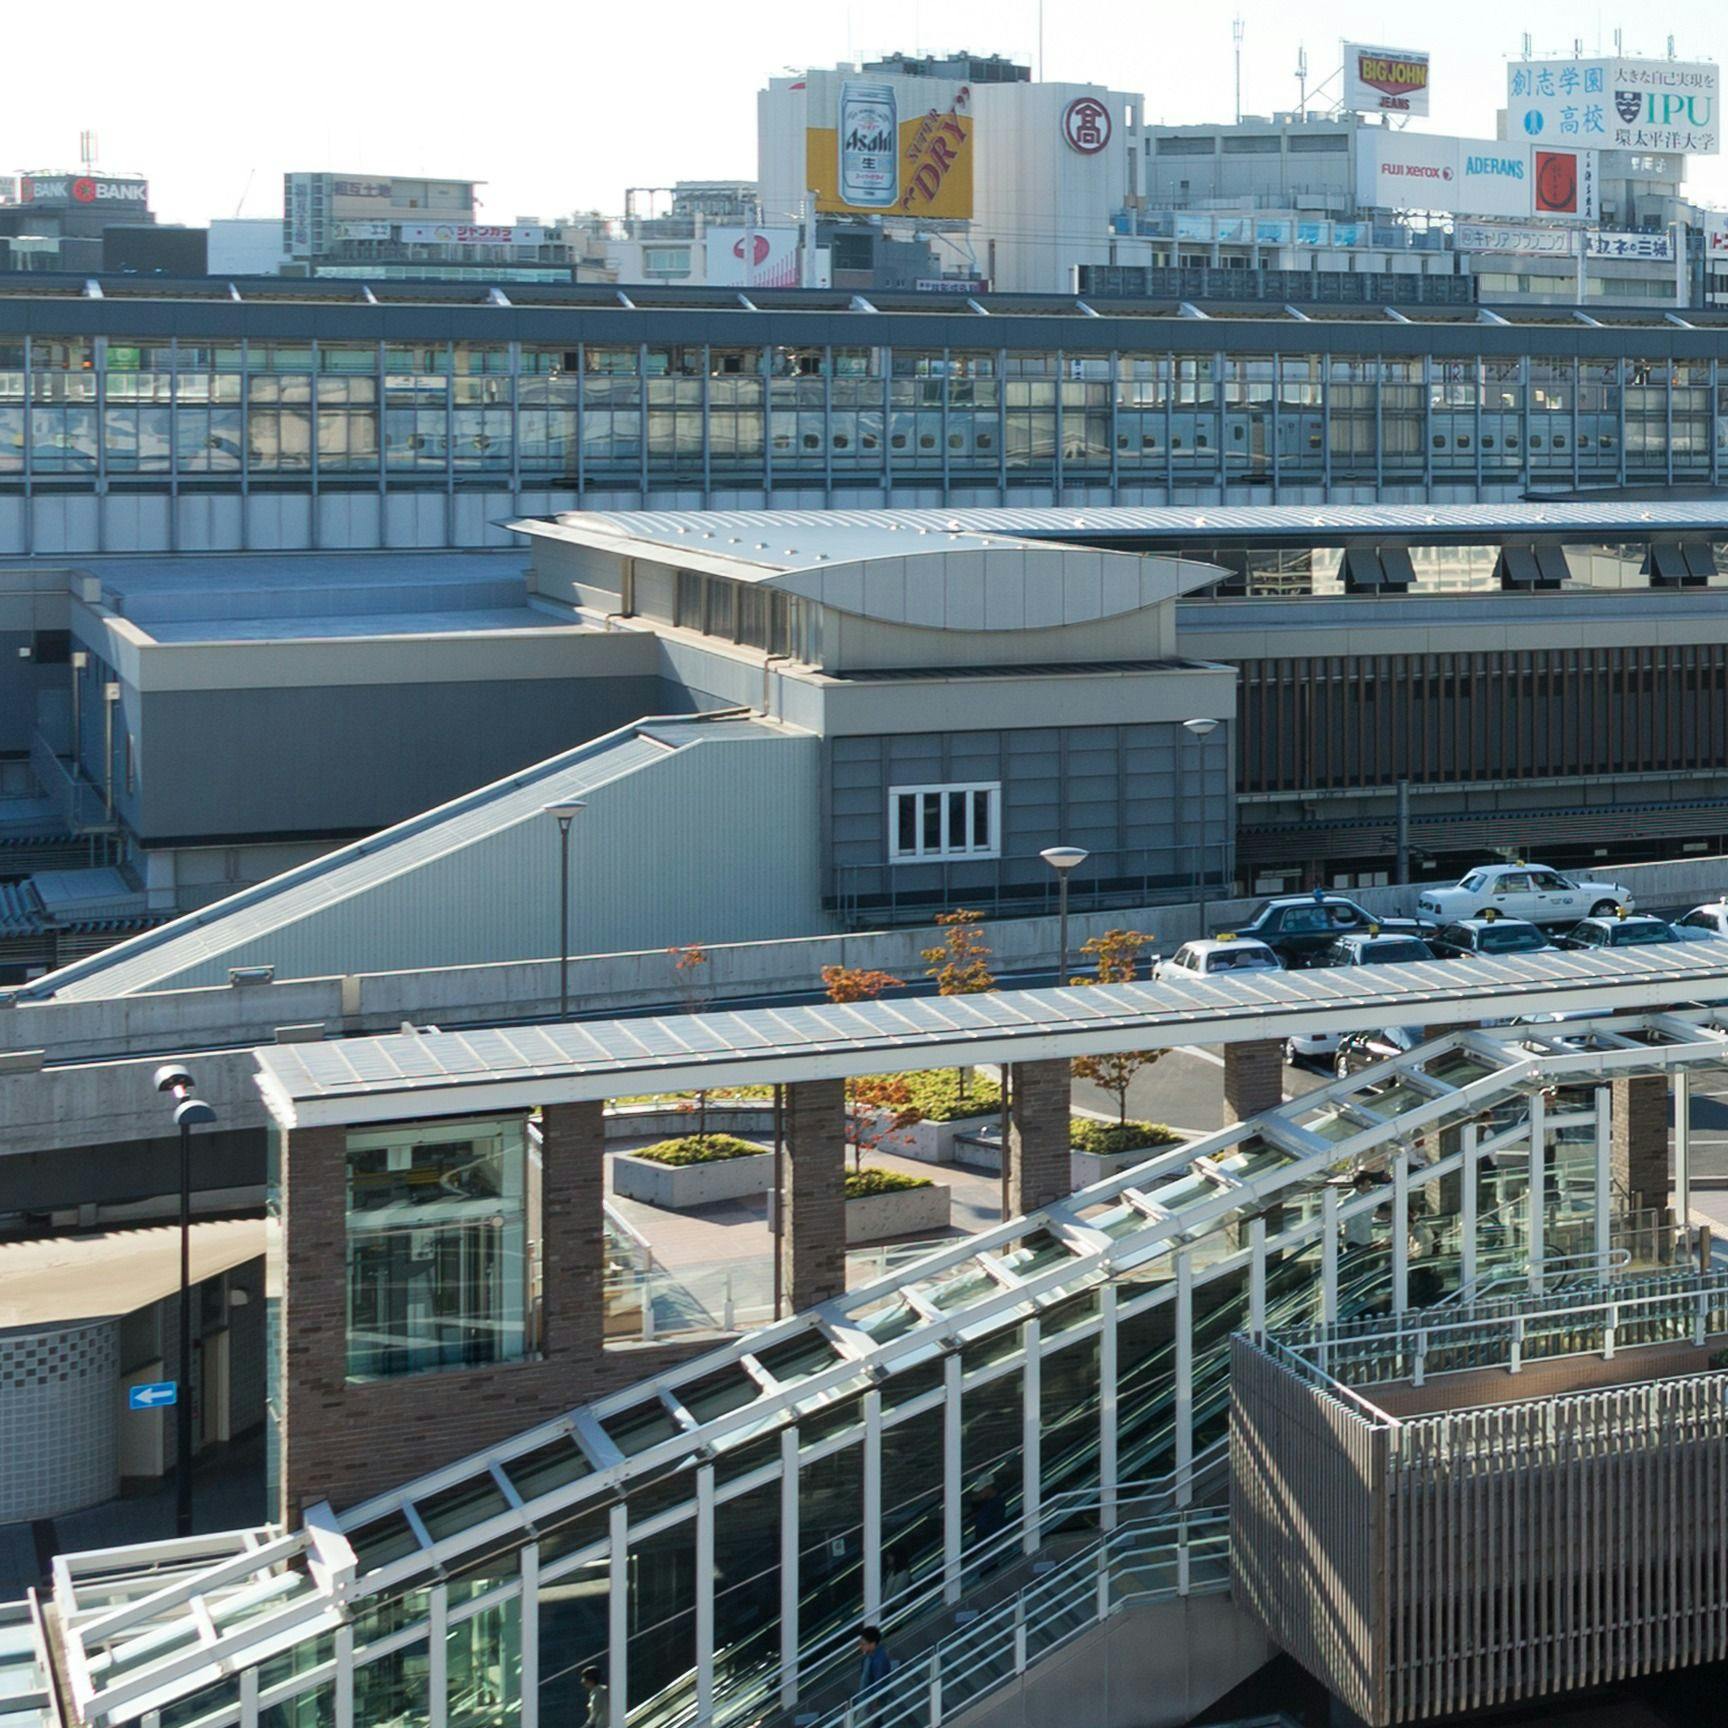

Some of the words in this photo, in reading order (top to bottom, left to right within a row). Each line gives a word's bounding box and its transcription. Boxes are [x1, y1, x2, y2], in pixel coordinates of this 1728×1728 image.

[1362, 58, 1387, 81] BIG
[1387, 62, 1427, 85] JOHN
[1511, 67, 1604, 97] 創志学園
[1614, 67, 1715, 89] 大きな自己実現を
[1379, 95, 1410, 110] JEANS
[1646, 92, 1713, 127] IPU
[1559, 104, 1605, 135] 高校
[845, 128, 892, 153] Asahi
[1614, 129, 1715, 151] 環太平洋大学
[861, 157, 876, 170] 生
[1381, 163, 1404, 175] FUJI
[1465, 156, 1524, 180] ADERANS
[34, 182, 68, 198] BANK
[96, 183, 147, 200] BANK
